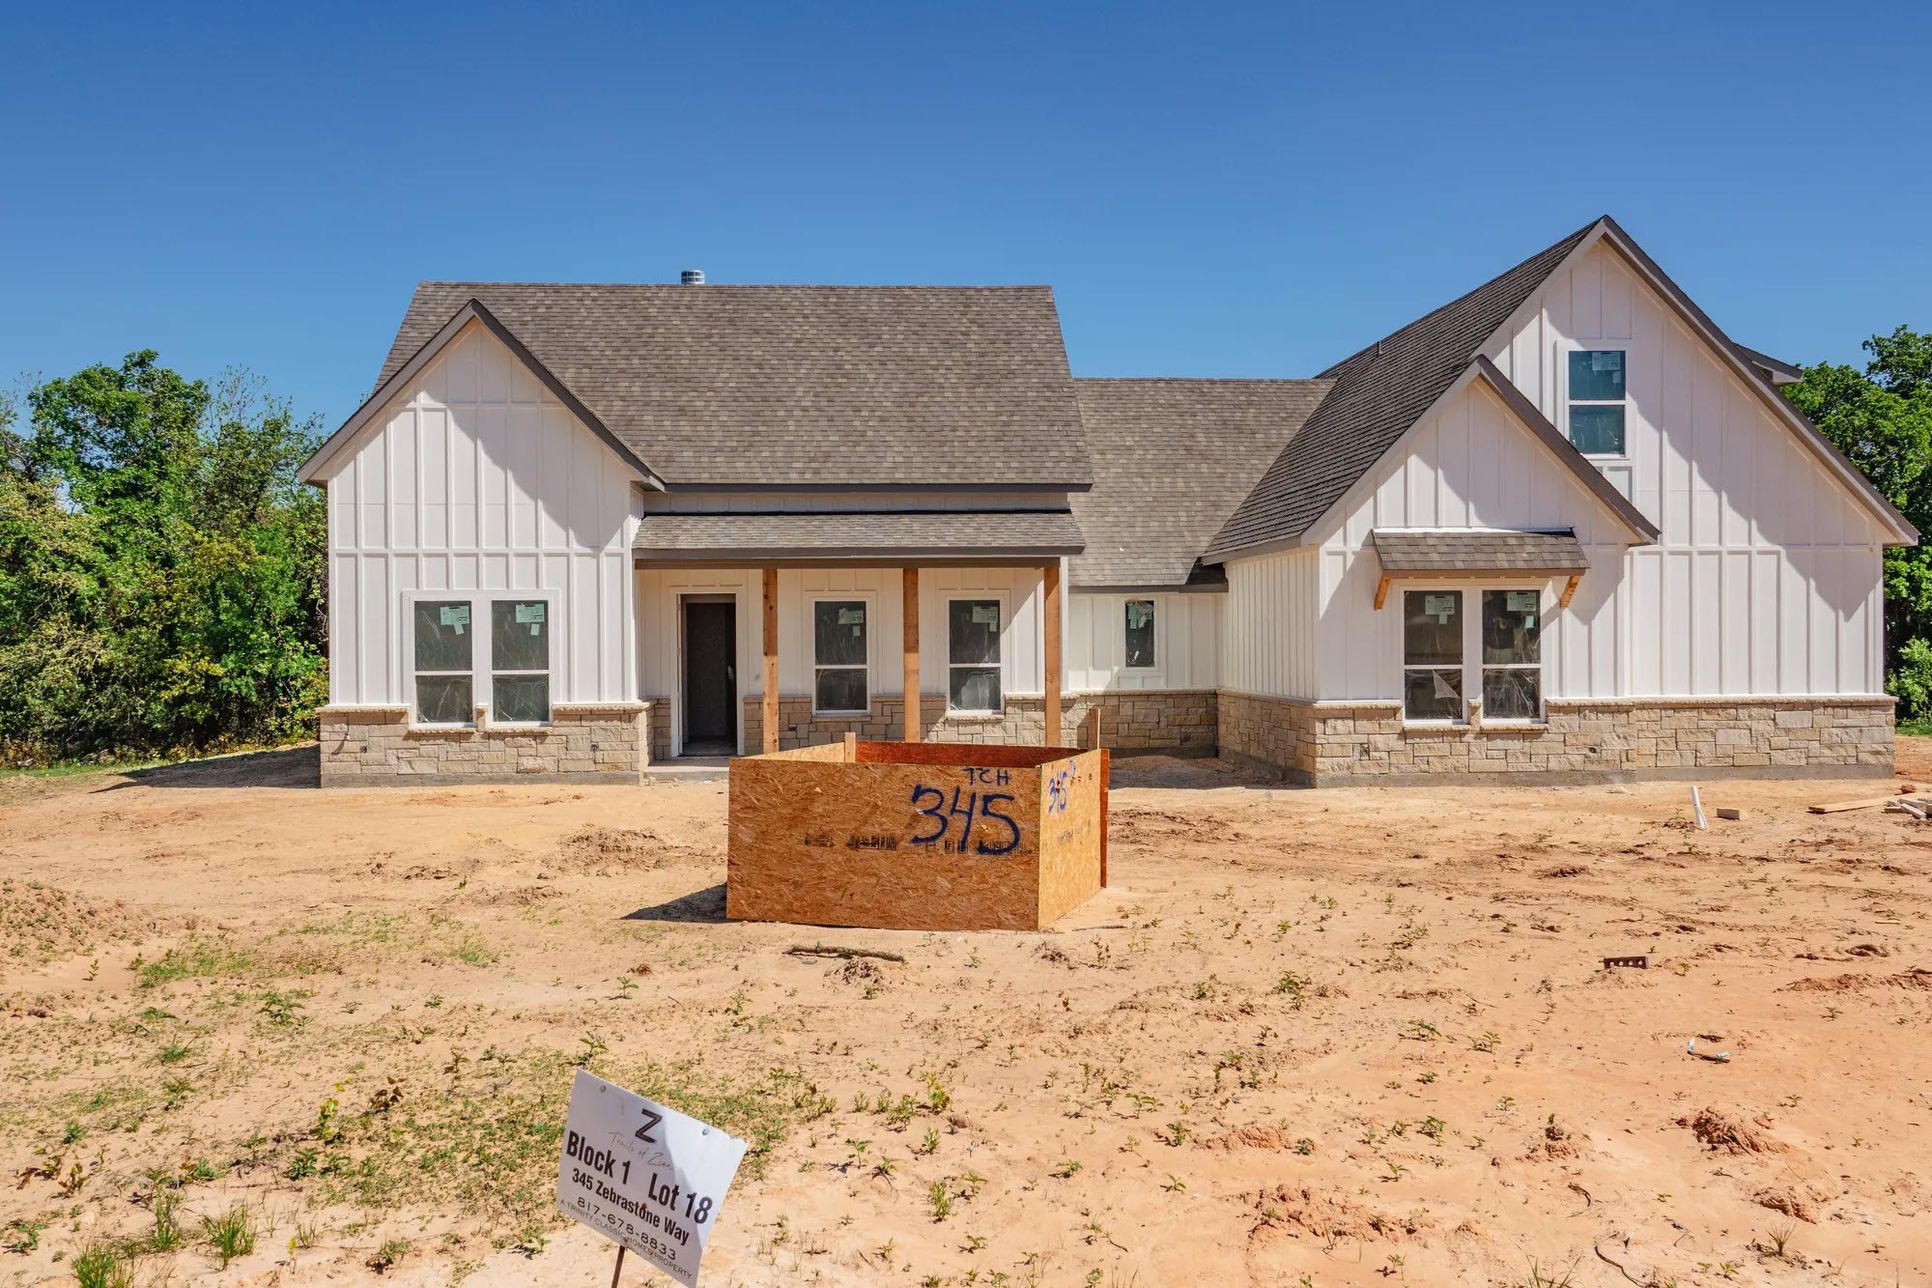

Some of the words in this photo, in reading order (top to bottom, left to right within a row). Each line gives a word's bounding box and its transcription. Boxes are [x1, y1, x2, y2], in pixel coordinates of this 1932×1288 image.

[962, 767, 1010, 786] TCH
[911, 783, 1020, 855] 345
[634, 1108, 663, 1144] Z
[566, 1130, 617, 1179] Block
[622, 1160, 631, 1185] 1
[648, 1172, 680, 1211] Lot
[685, 1191, 713, 1225] 18
[572, 1168, 594, 1191] 345
[596, 1180, 660, 1228] Zebrastone
[664, 1216, 690, 1247] Way
[566, 1203, 594, 1221] TRINITY
[654, 1252, 692, 1279] PROPERTY
[577, 1196, 676, 1260] 817-678-8833
